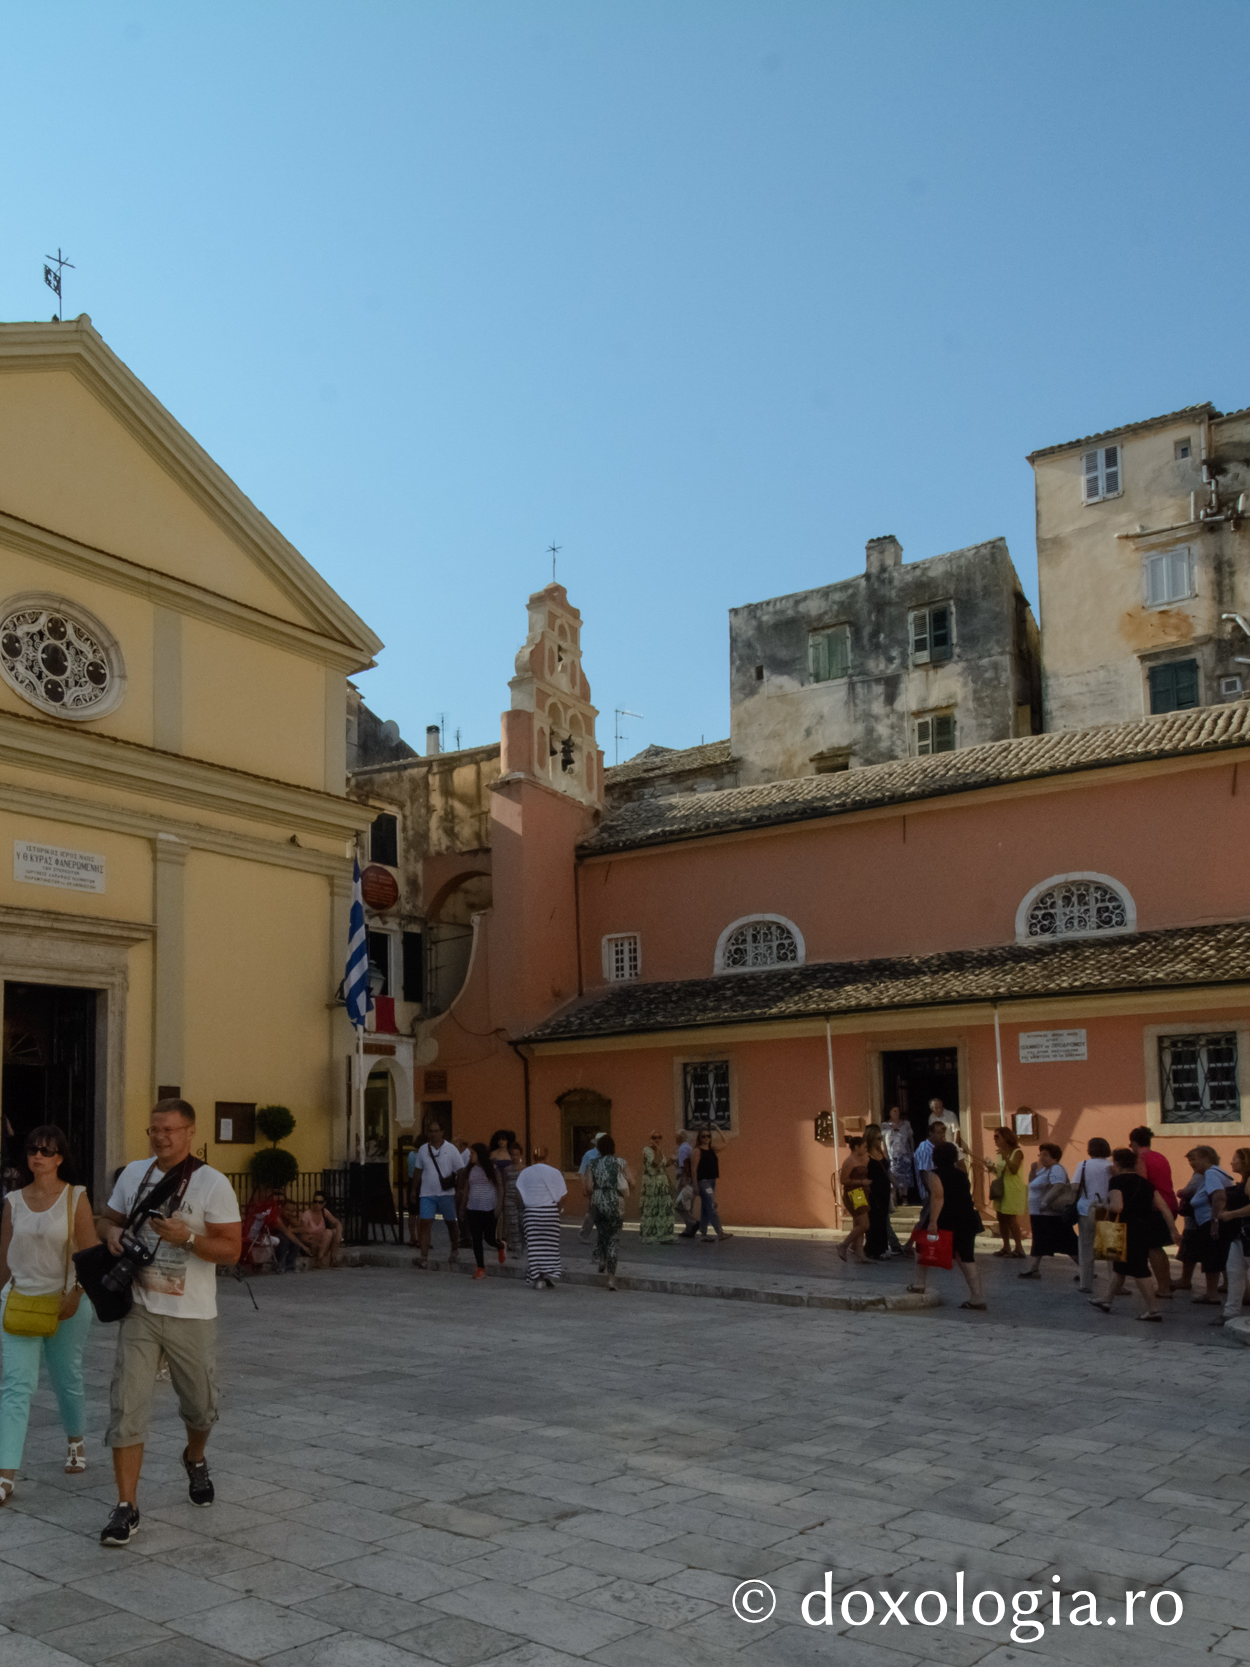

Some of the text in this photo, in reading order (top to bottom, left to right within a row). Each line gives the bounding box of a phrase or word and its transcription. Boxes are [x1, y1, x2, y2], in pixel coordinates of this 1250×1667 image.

[26, 845, 58, 856] ΙΣΤΟΡΙΚΟΣ
[30, 854, 53, 865] ΚΥΡΑΣ
[55, 858, 104, 874] ΦΑΝΕΡΩΜΕΝΗΣ
